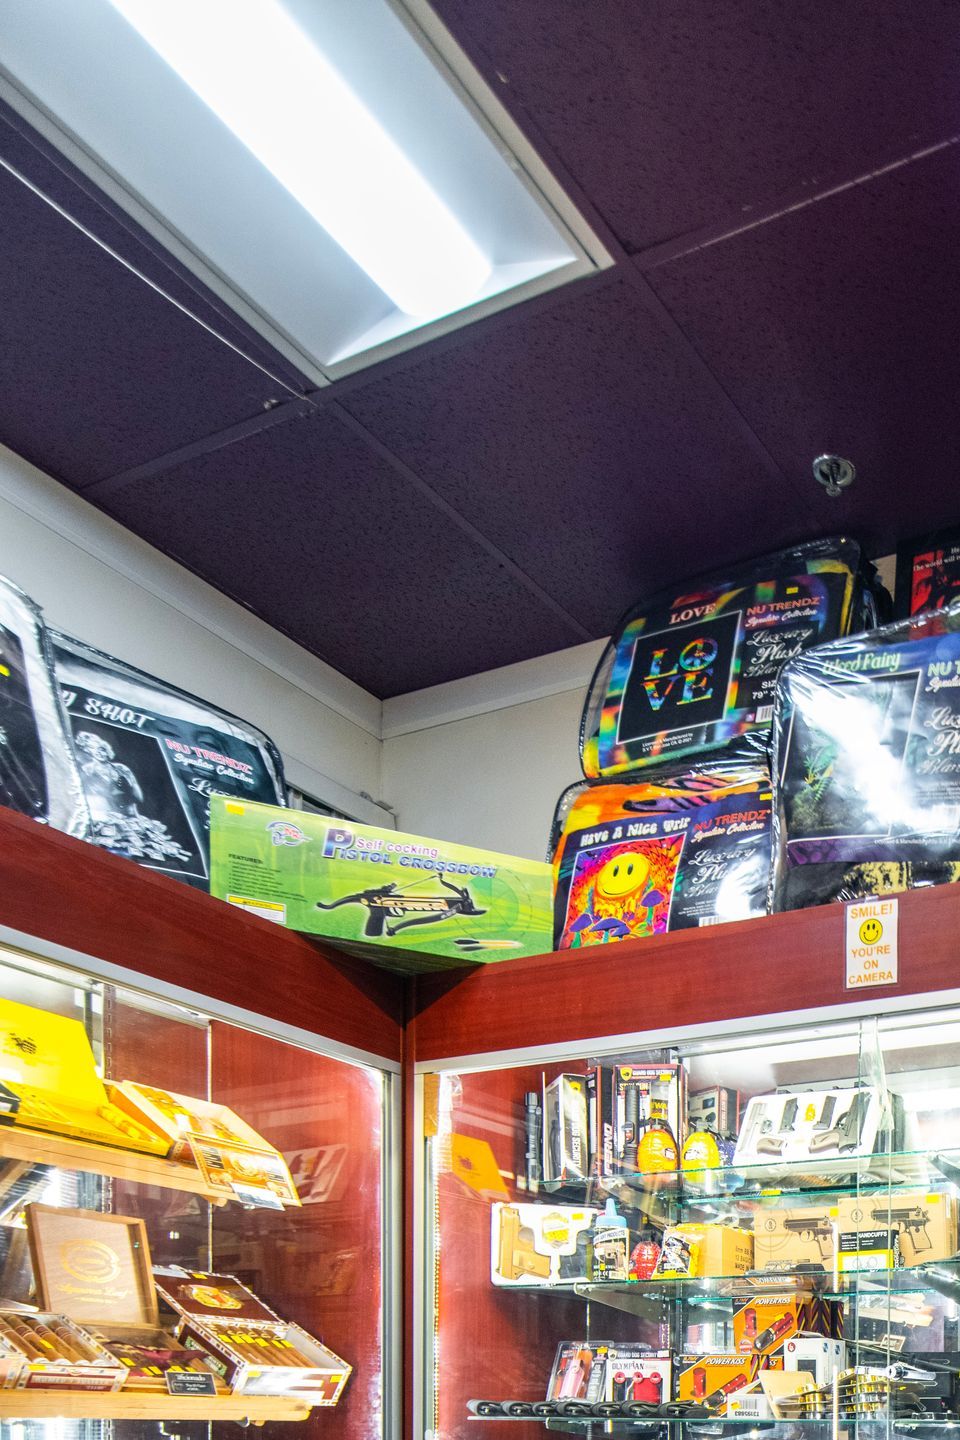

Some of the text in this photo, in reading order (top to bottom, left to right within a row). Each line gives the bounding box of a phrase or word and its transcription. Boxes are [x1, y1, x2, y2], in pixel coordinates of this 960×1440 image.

[669, 603, 716, 625] LOVE
[745, 597, 820, 616] NU TRENDZ
[746, 627, 814, 647] Luxury
[927, 662, 951, 677] NU
[85, 697, 156, 729] SHOT
[692, 808, 768, 832] NU TRENDZ
[321, 827, 499, 878] PISTOL CROSSBOW
[354, 837, 439, 860] Self cocking
[688, 847, 756, 867] Luxury
[850, 902, 893, 919] SMILE!
[850, 944, 891, 959] YOU'RE
[863, 958, 879, 970] ON
[848, 970, 894, 985] CAMERA
